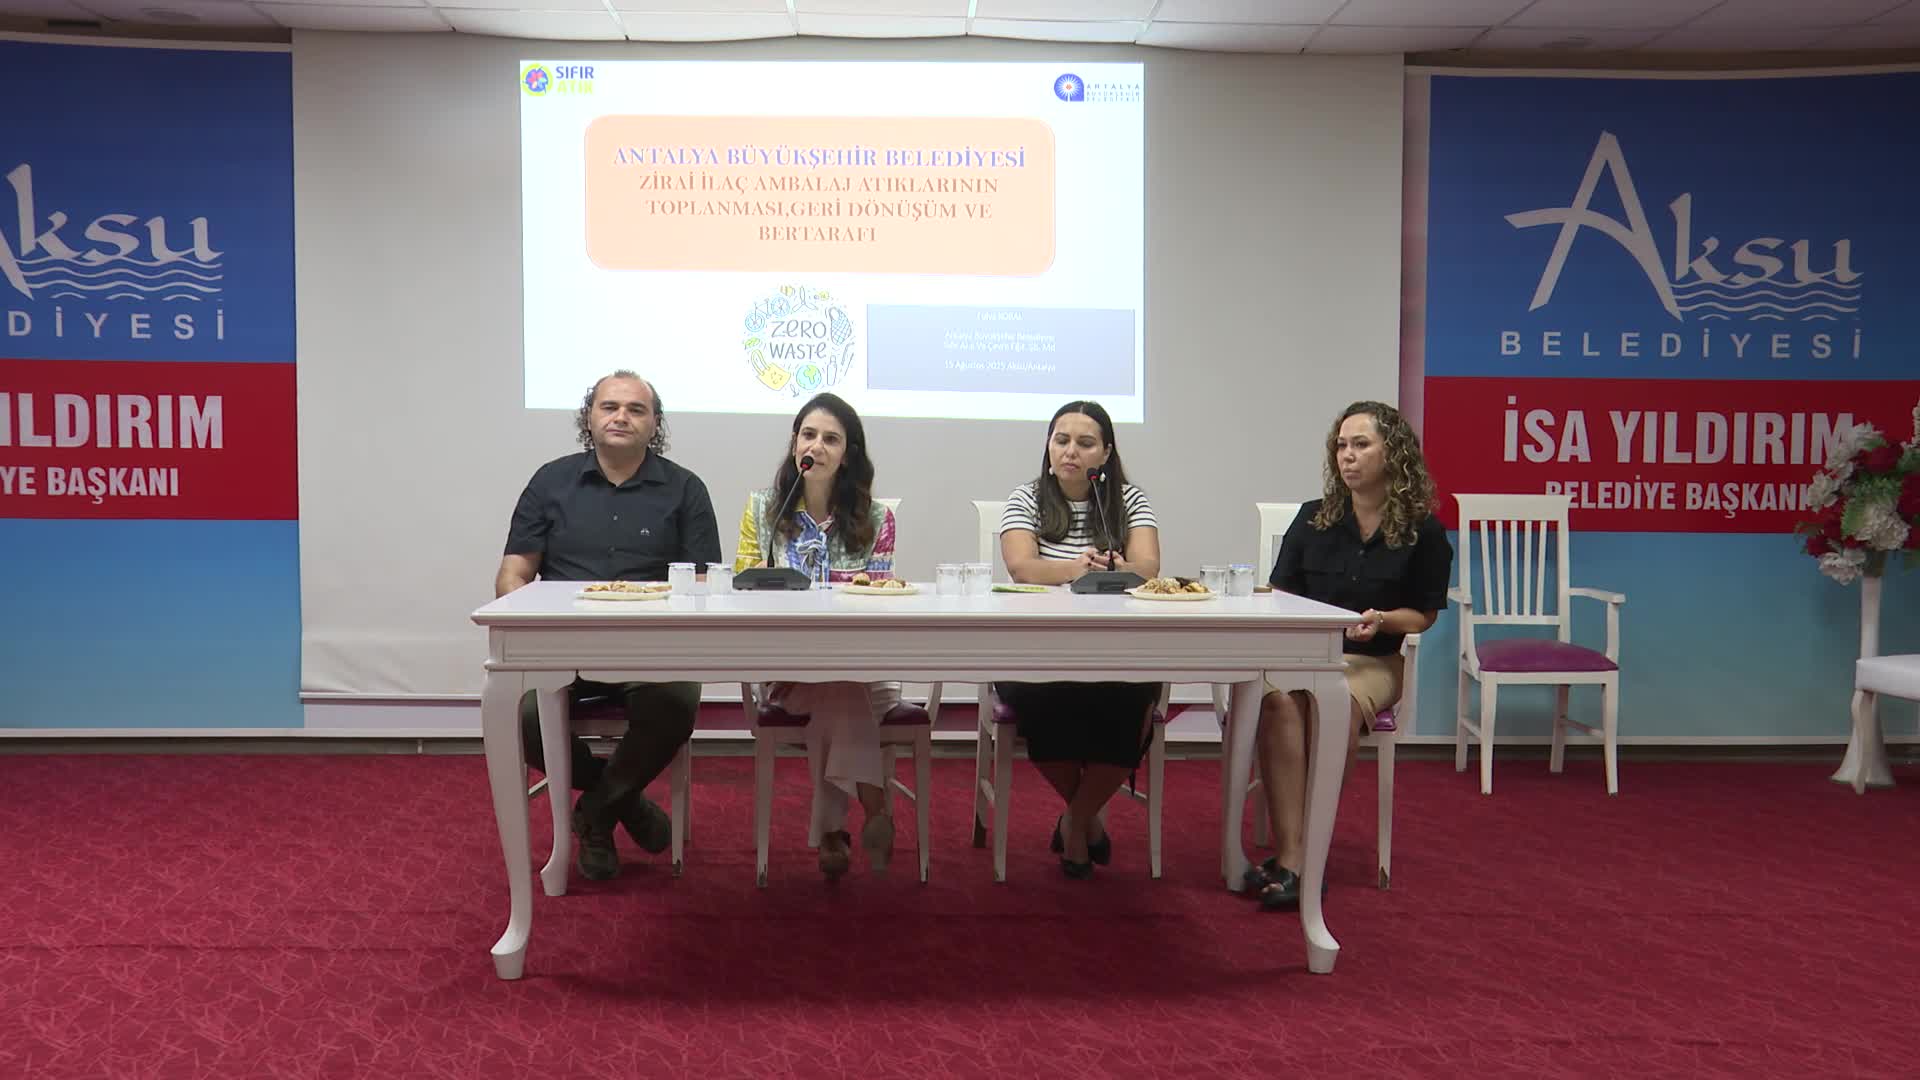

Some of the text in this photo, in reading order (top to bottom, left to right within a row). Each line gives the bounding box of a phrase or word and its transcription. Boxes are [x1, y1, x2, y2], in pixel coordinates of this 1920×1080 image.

[555, 66, 594, 79] SIFIR
[614, 144, 1025, 169] ANTALYA BÜYÜKŞEHİR BELEDİYESİ
[639, 171, 998, 194] ZİRAİ İLAÇ AMBALAJ ATIKLARININ
[848, 199, 957, 222] DÖNÜŞÜM
[964, 204, 993, 219] VE
[1504, 131, 1864, 322] Aksu
[0, 163, 225, 299] ksu
[758, 226, 877, 242] BERTARAFI
[8, 305, 224, 341] DİYESİ
[1501, 329, 1862, 359] BELEDİYESİ
[1503, 395, 1854, 465] İSA YILDIRIM
[47, 466, 179, 505] BAŞKANI
[1685, 482, 1808, 518] BAŞKANI
